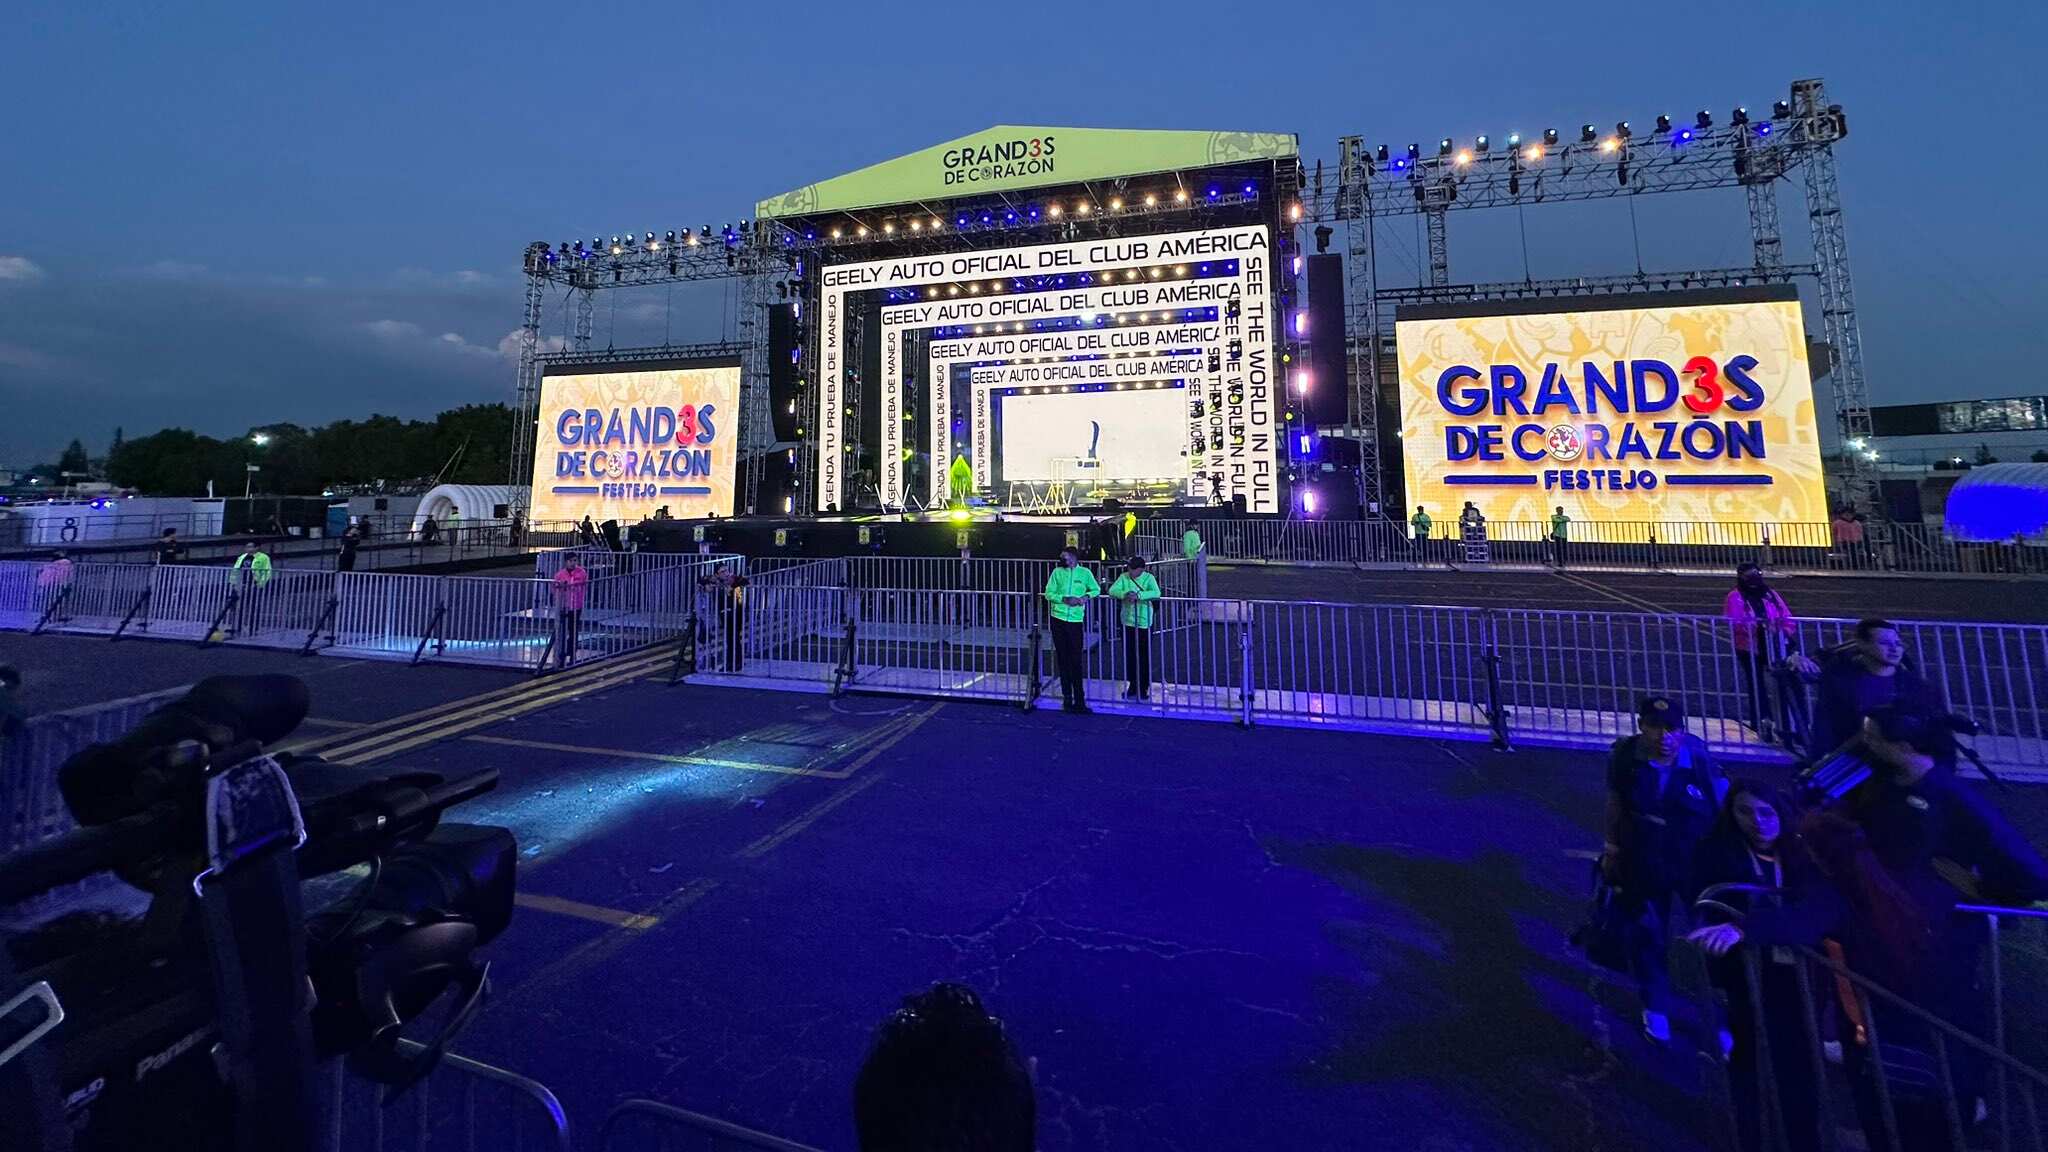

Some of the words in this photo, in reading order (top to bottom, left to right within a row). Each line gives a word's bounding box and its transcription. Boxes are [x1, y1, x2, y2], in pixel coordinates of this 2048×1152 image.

[944, 137, 1055, 168] GRAND3S
[945, 170, 964, 184] DE
[823, 266, 883, 287] GEELY
[890, 261, 944, 281] AUTO
[952, 253, 1030, 275] OFICIAL
[1039, 249, 1081, 267] DEL
[1090, 243, 1148, 263] CLUB
[1157, 231, 1267, 258] AMÉRICA
[1246, 257, 1263, 296] SEE
[882, 307, 932, 325] GEELY
[938, 303, 983, 320] AUTO
[989, 297, 1054, 316] OFICIAL
[1060, 293, 1095, 310] DEL
[1101, 289, 1149, 306] CLUB
[1156, 280, 1240, 303] AMÉRICA
[828, 294, 836, 348] MANEJO
[1247, 301, 1265, 343] THE
[888, 332, 896, 376] MANEJO
[931, 343, 973, 358] GEELY
[977, 340, 1014, 355] AUTO
[1020, 336, 1072, 353] OFICIAL
[1078, 335, 1106, 349] DEL
[1111, 332, 1150, 347] CLUB
[828, 351, 836, 370] DE
[971, 370, 1006, 384] GEELY
[1009, 368, 1039, 382] AUTO
[1043, 365, 1085, 381] OFICIAL
[1089, 364, 1112, 378] DEL
[1116, 362, 1146, 375] CLUB
[888, 379, 896, 393] DE
[936, 364, 944, 400] MANEJO
[1189, 377, 1201, 397] SEE
[1248, 350, 1267, 425] WORLD
[1436, 354, 1766, 417] GRAND3S
[827, 374, 836, 428] PRUEBA
[937, 402, 944, 416] DE
[556, 404, 716, 446] GRAND3S
[888, 396, 896, 440] PRUEBA
[977, 418, 984, 428] DE
[827, 433, 835, 451] TU
[937, 416, 945, 450] PRUEBA
[977, 430, 985, 456] PRUEBA
[1252, 433, 1268, 452] IN
[1445, 424, 1505, 462] DE
[555, 451, 586, 477] DE
[888, 443, 896, 459] TU
[937, 455, 945, 468] TU
[978, 458, 985, 469] TU
[1211, 455, 1224, 467] IN
[602, 482, 657, 498] FESTEJO
[826, 455, 834, 502] GENDA
[1231, 463, 1246, 496] FUL
[1252, 460, 1270, 512] FULL
[1544, 469, 1658, 490] FESTEJO
